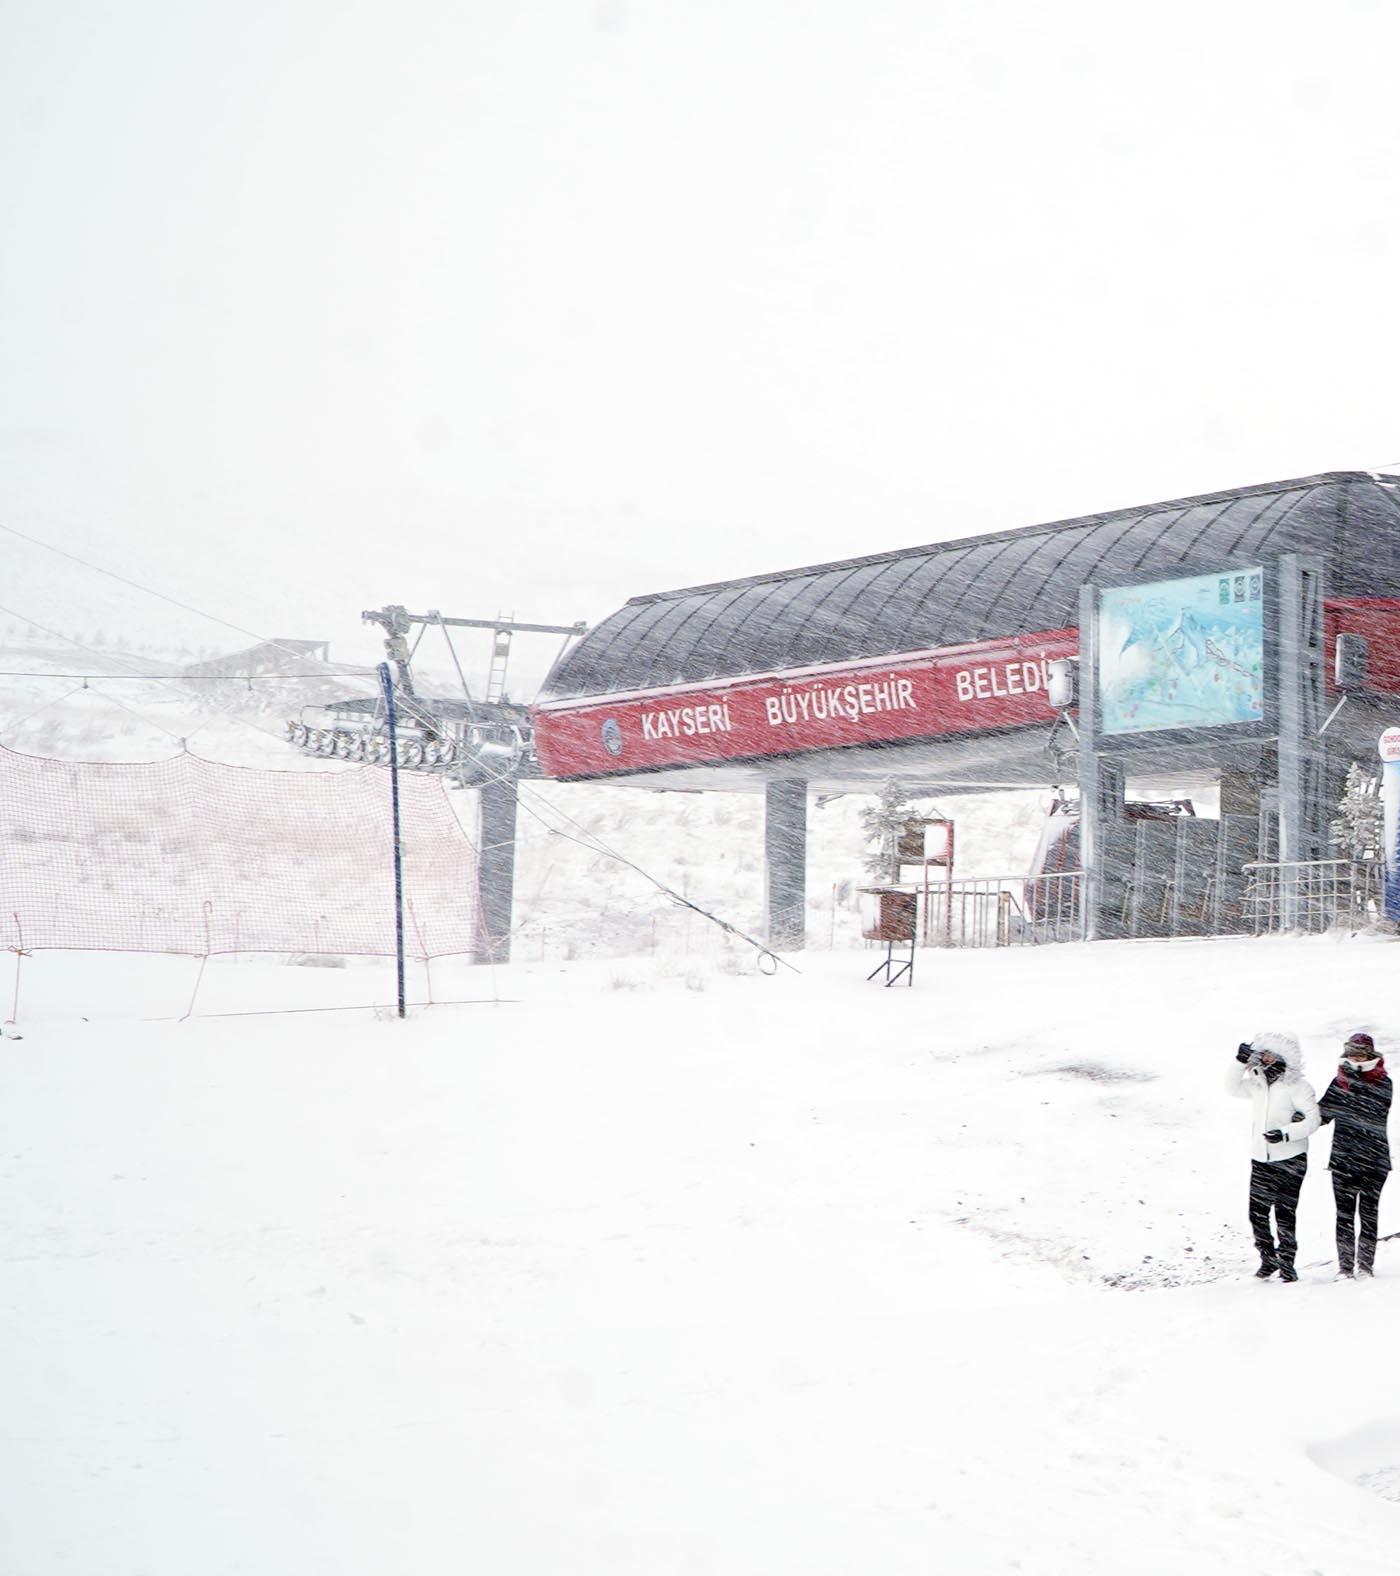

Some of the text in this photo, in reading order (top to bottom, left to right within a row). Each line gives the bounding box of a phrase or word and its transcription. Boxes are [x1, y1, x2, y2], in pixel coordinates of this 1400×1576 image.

[641, 651, 1053, 741] KAYSERİ BÜYÜKŞEHİR BELEDİ
